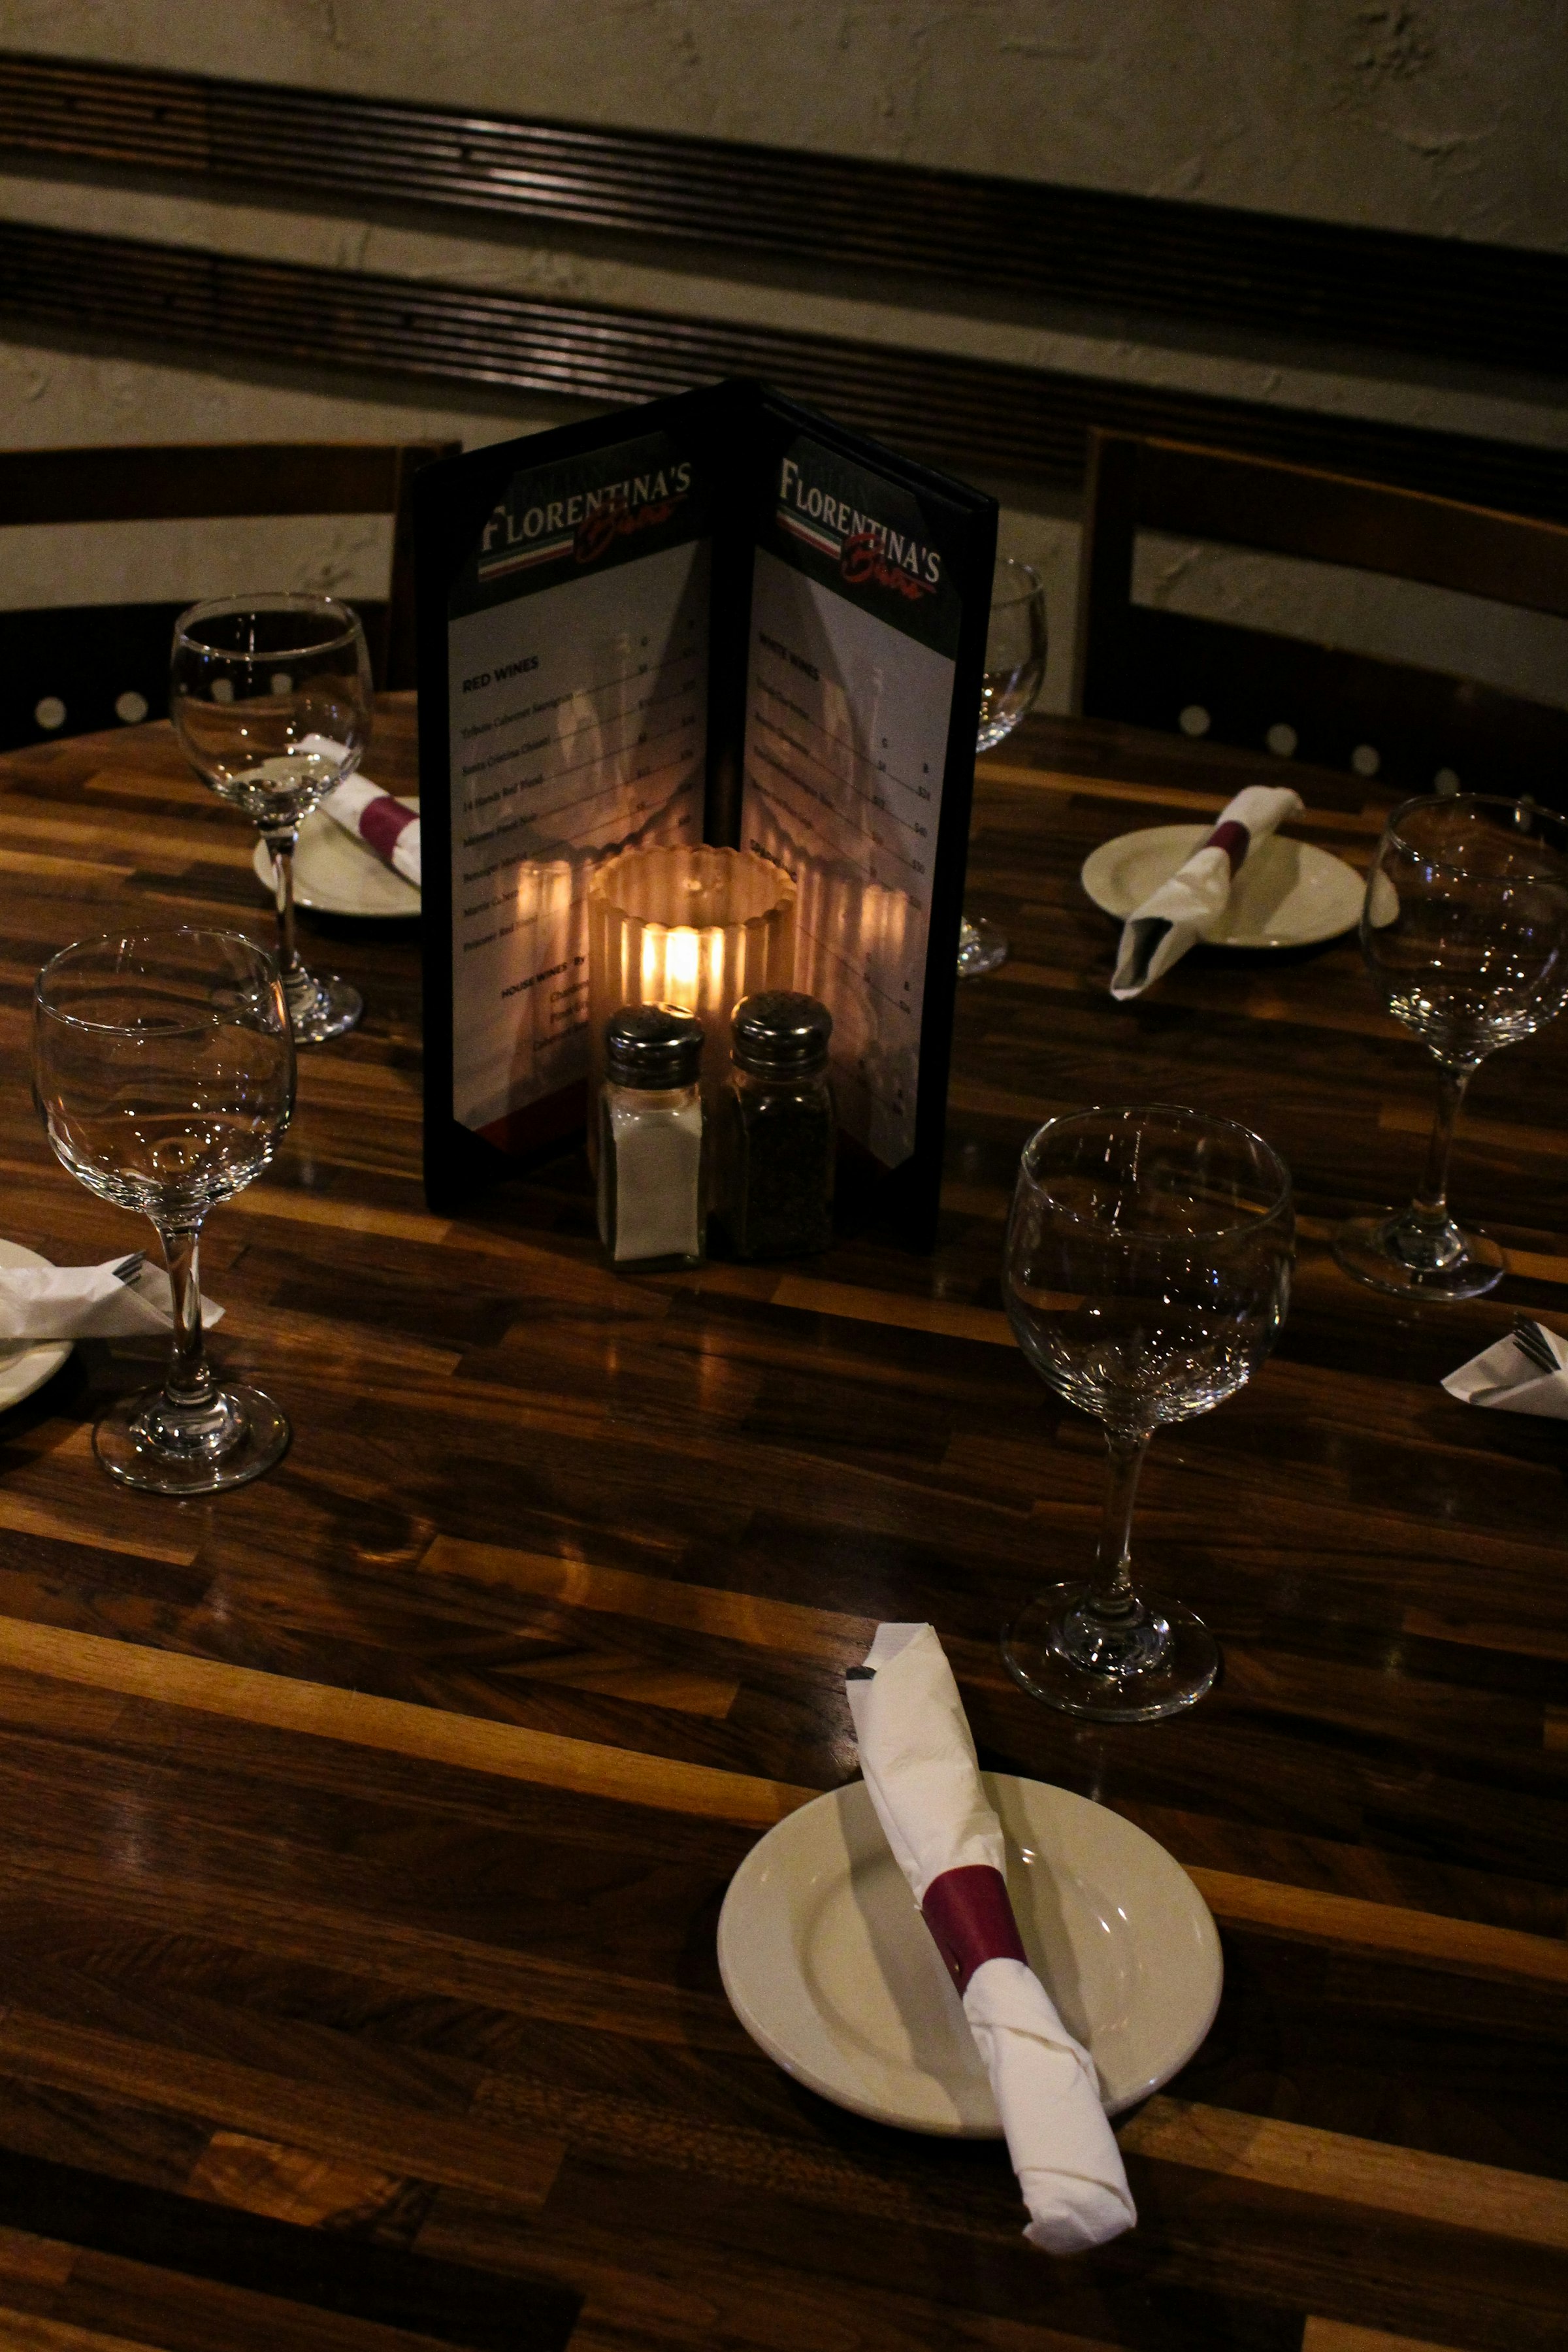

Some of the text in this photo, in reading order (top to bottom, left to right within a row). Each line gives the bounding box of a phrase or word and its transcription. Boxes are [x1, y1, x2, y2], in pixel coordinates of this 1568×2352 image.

[481, 461, 693, 552] FLORENTINA'S
[779, 457, 941, 583] FLORENTINA'S
[462, 655, 539, 694] RED WINES
[788, 652, 820, 682] WINES
[500, 976, 535, 999] HOUSE
